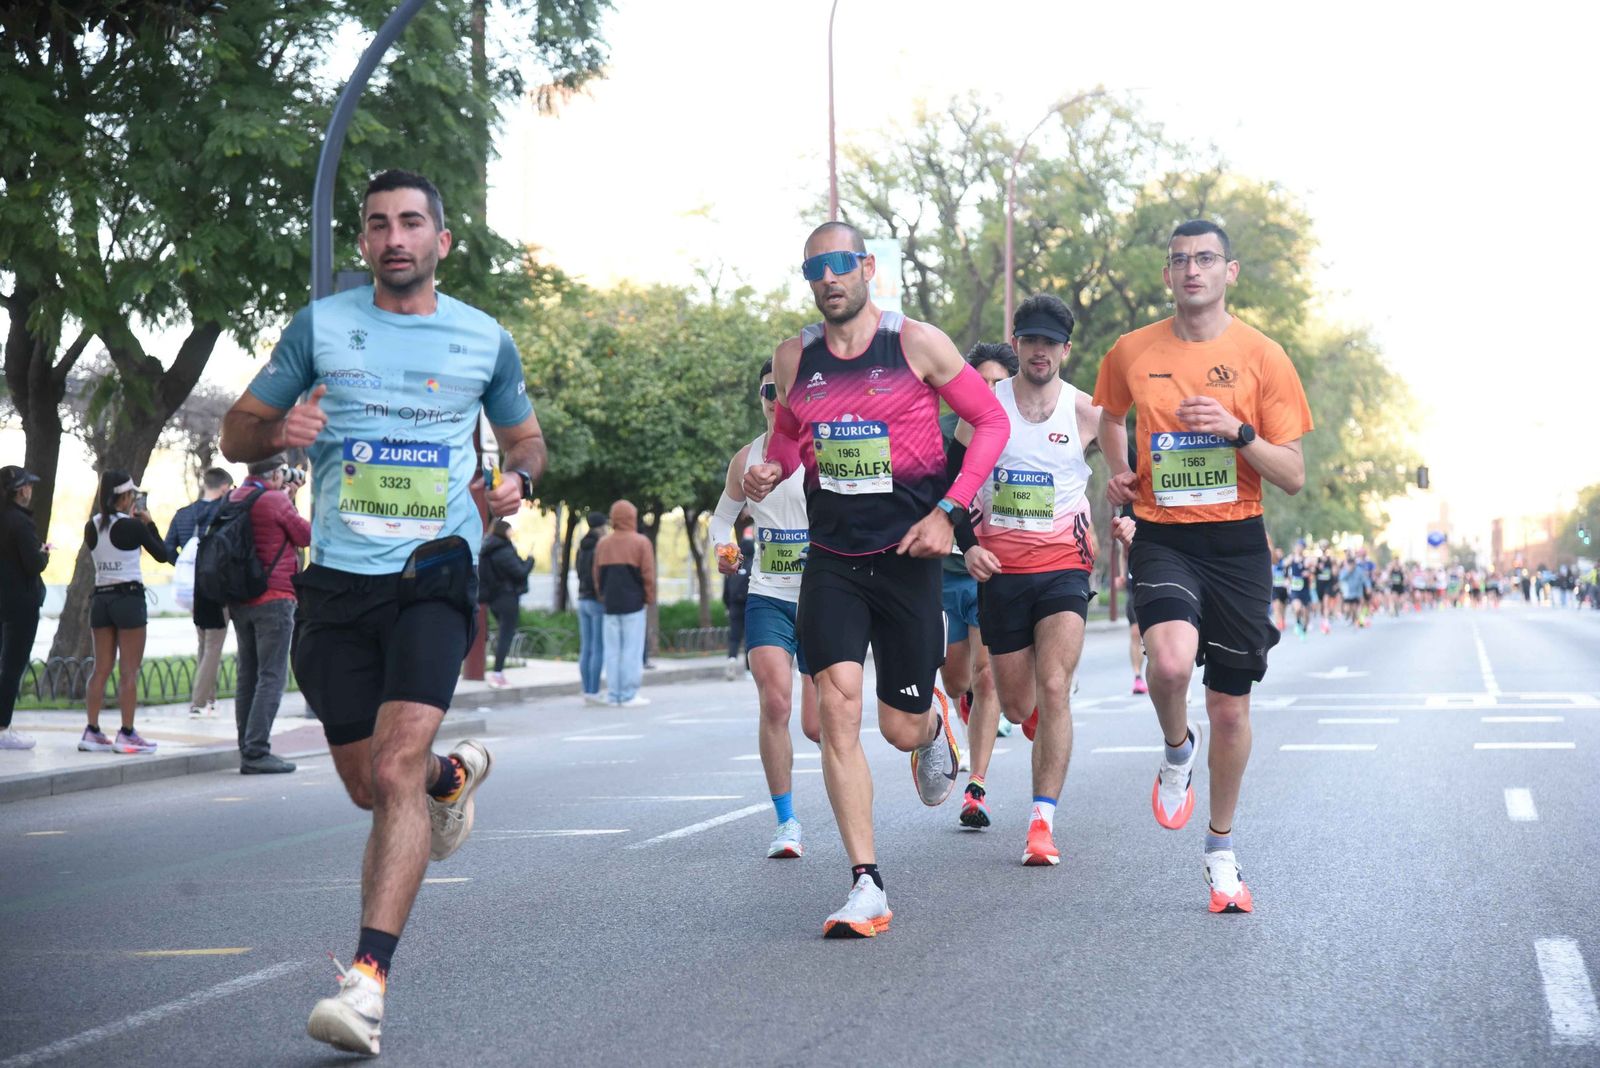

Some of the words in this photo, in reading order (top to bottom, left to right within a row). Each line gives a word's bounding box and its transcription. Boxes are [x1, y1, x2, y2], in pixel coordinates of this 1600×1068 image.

[835, 425, 880, 436] ZURICH
[1179, 434, 1225, 446] ZURICH
[379, 447, 438, 463] ZURICH
[836, 448, 860, 458] 1963
[1181, 457, 1206, 467] 1563
[819, 460, 891, 477] AGUS-ÁLEX
[379, 476, 411, 490] 3323
[1012, 473, 1048, 483] ZURICH
[1161, 470, 1228, 488] GUILLEM
[1012, 491, 1031, 500] 1682
[340, 499, 398, 516] ANTONIO
[403, 501, 446, 519] JÓDAR
[1016, 506, 1054, 518] MANNING
[775, 532, 807, 540] ZURICH
[776, 549, 793, 557] 1922
